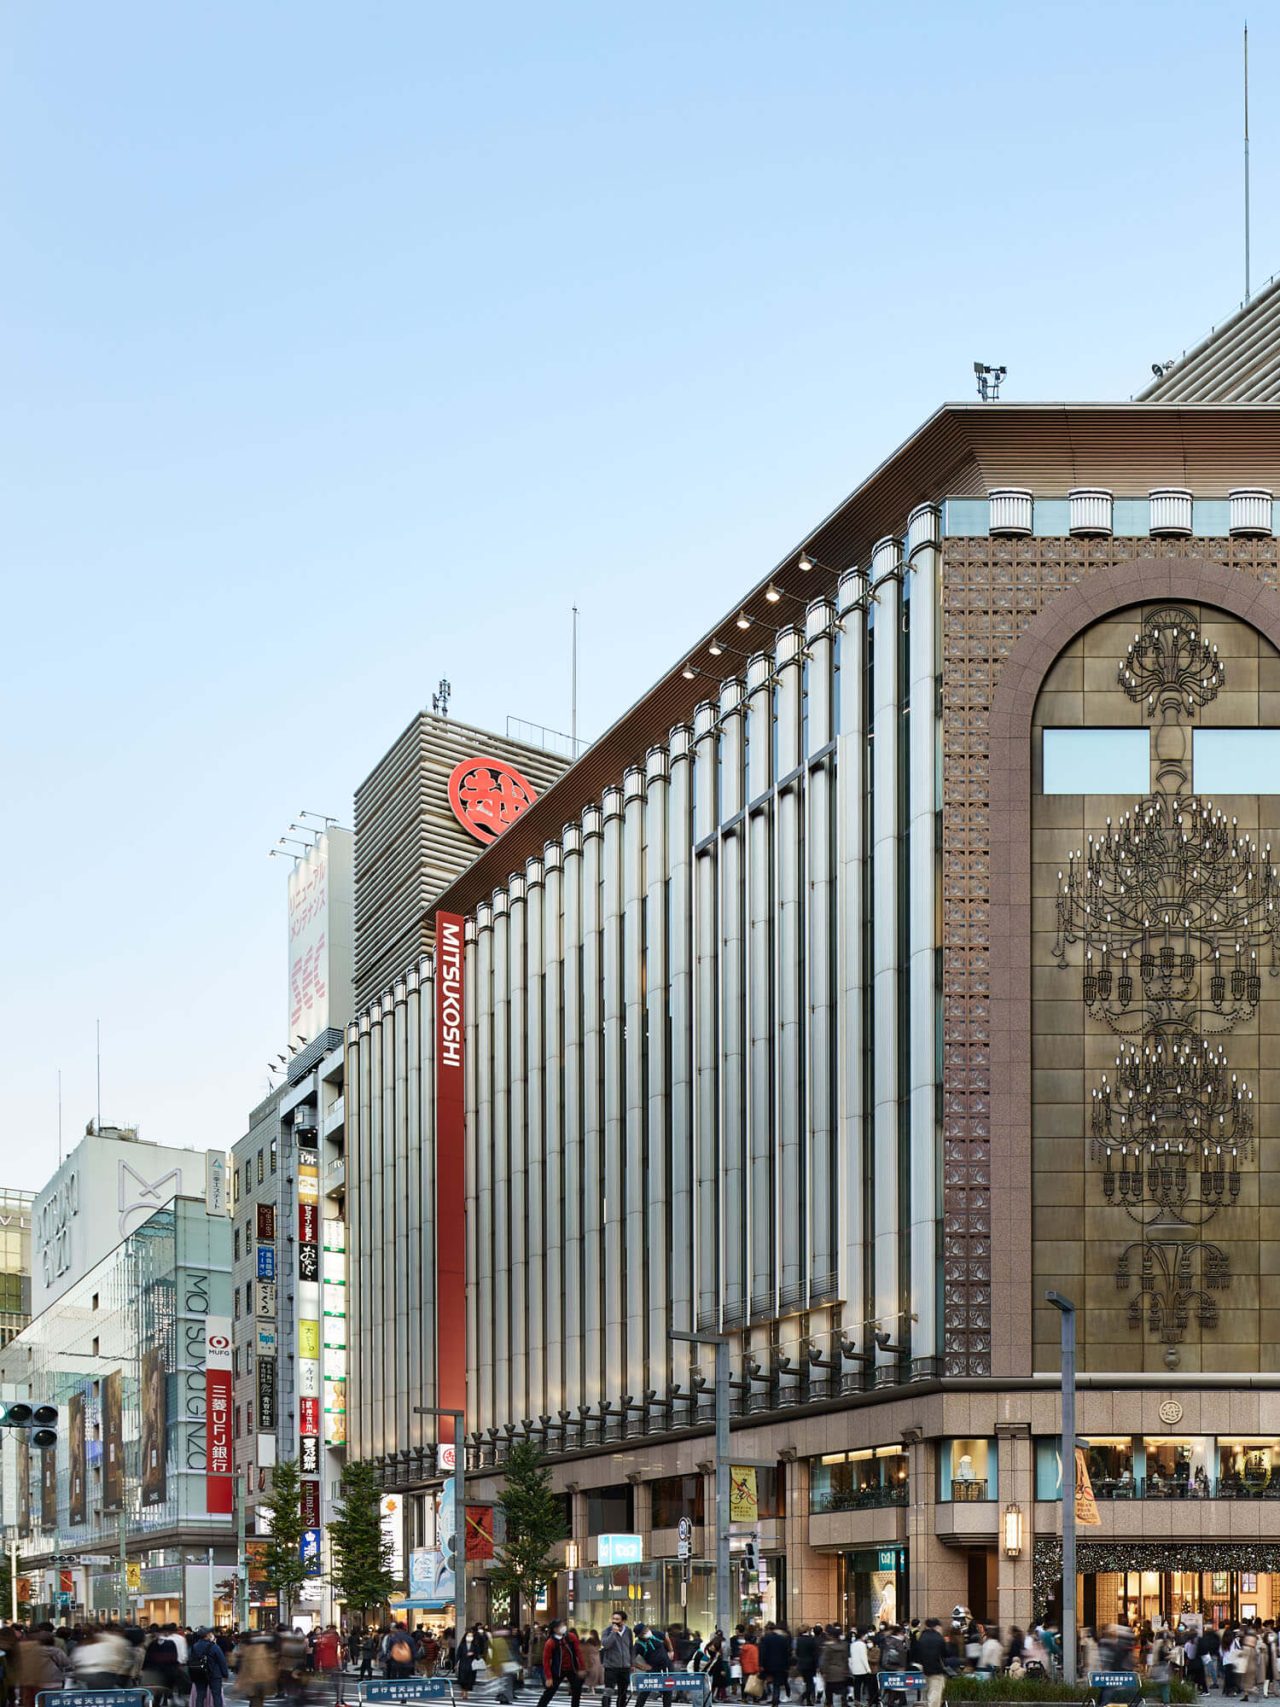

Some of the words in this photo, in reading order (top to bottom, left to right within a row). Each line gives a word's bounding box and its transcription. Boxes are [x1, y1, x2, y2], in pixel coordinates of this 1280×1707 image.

[443, 923, 460, 1067] MITSUKOSHI
[212, 1385, 227, 1472] 三菱UFJ銀行
